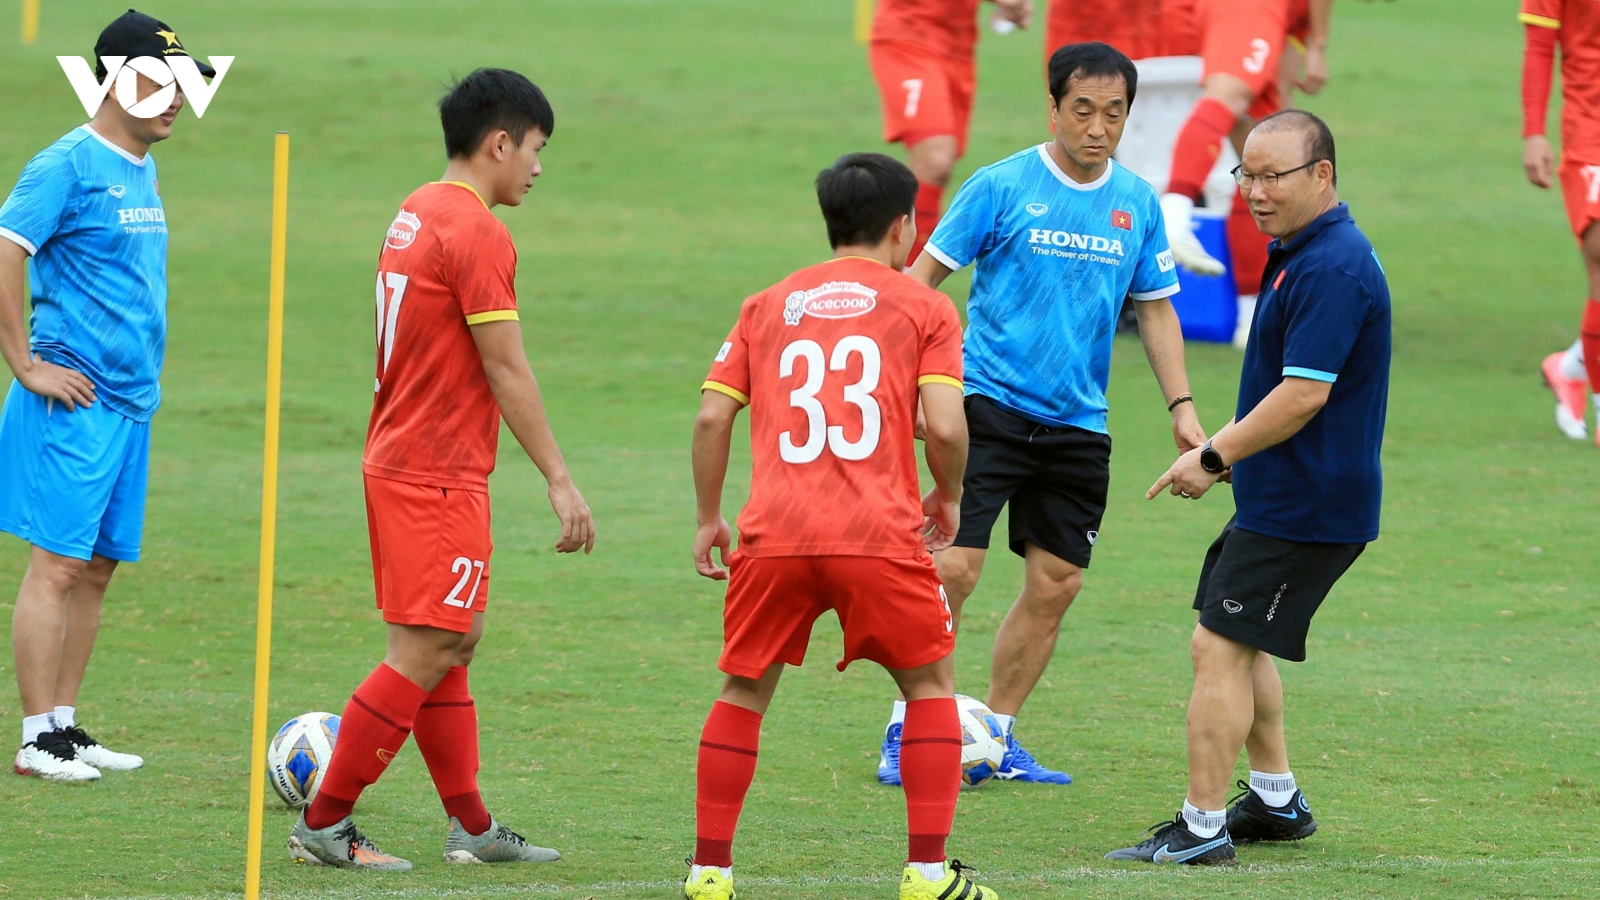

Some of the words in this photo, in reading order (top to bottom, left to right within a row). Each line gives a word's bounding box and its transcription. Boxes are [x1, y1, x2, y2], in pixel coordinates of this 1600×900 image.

[1242, 37, 1270, 75] 3
[901, 78, 923, 118] 7
[1028, 228, 1125, 257] HONDA
[1032, 246, 1050, 256] The
[1051, 249, 1078, 259] Power
[1078, 252, 1089, 261] of
[779, 335, 882, 464] 33
[442, 556, 485, 610] 27
[276, 764, 299, 802] molten
